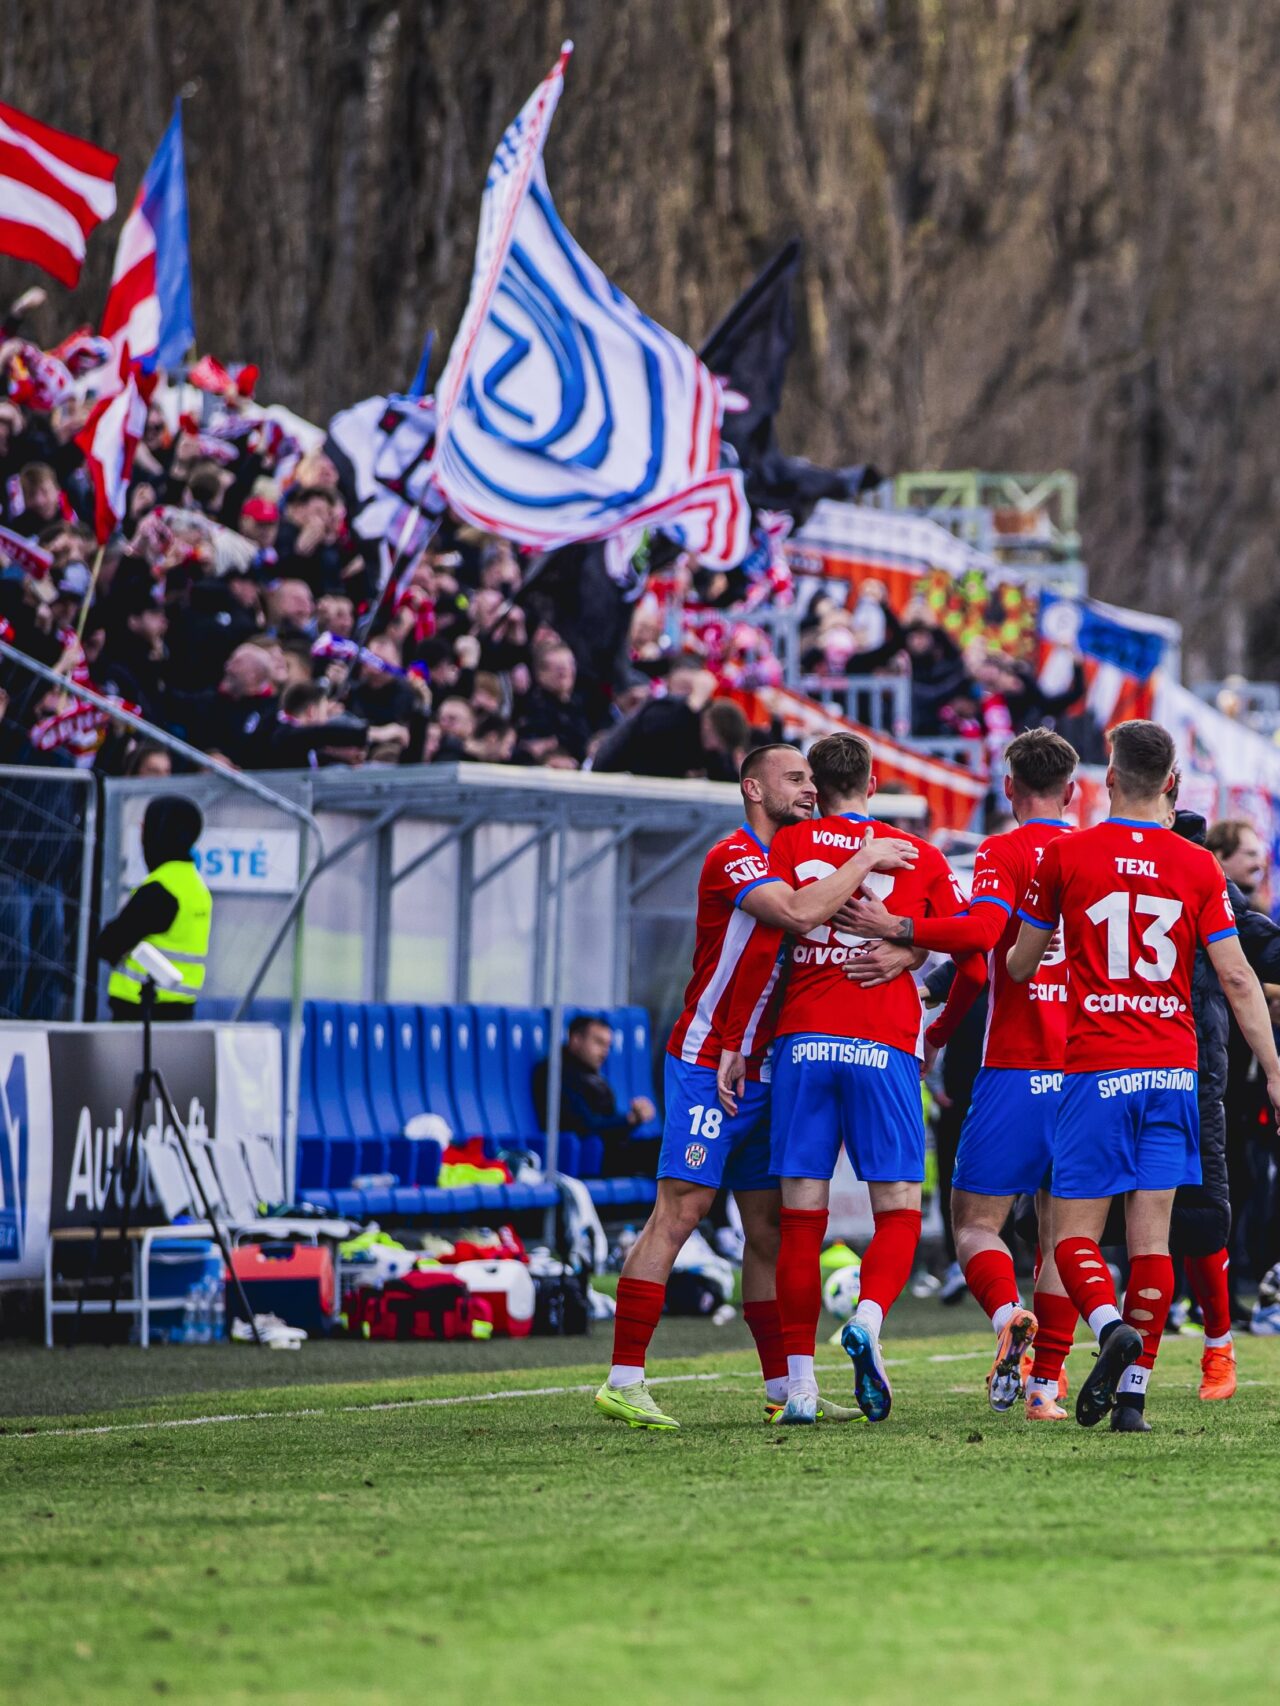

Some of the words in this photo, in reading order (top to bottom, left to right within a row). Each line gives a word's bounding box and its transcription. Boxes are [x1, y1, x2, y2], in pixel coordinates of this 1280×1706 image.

[812, 831, 863, 850] VORLI
[1115, 857, 1159, 879] TEXL
[1085, 891, 1184, 982] 13
[689, 1104, 723, 1140] 18
[1130, 1373, 1144, 1386] 13
